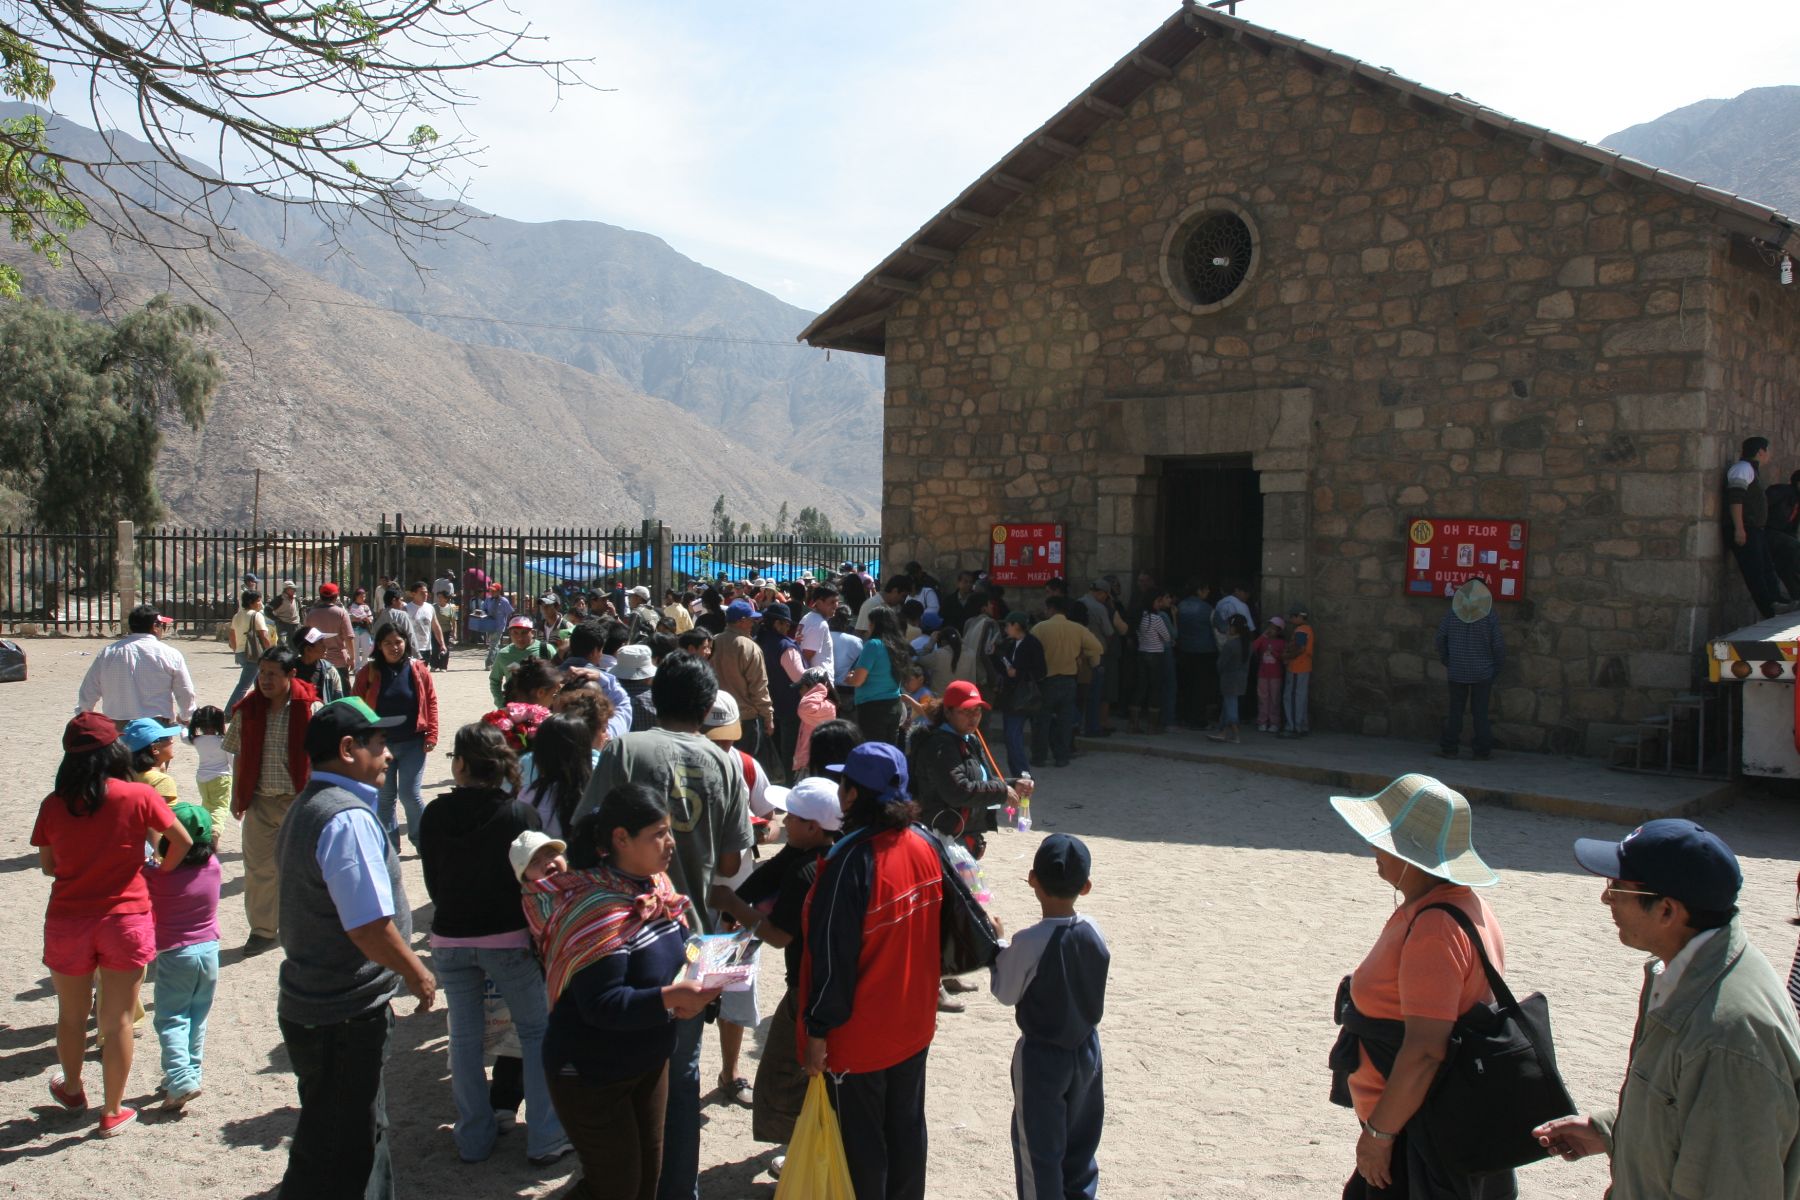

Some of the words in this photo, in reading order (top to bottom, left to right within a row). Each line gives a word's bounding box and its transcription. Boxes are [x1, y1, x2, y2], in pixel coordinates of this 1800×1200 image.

[1010, 529, 1029, 538] ROSA
[1033, 528, 1043, 537] DE
[1443, 525, 1460, 535] OH
[1468, 525, 1498, 536] FLOR
[670, 763, 704, 832] 5
